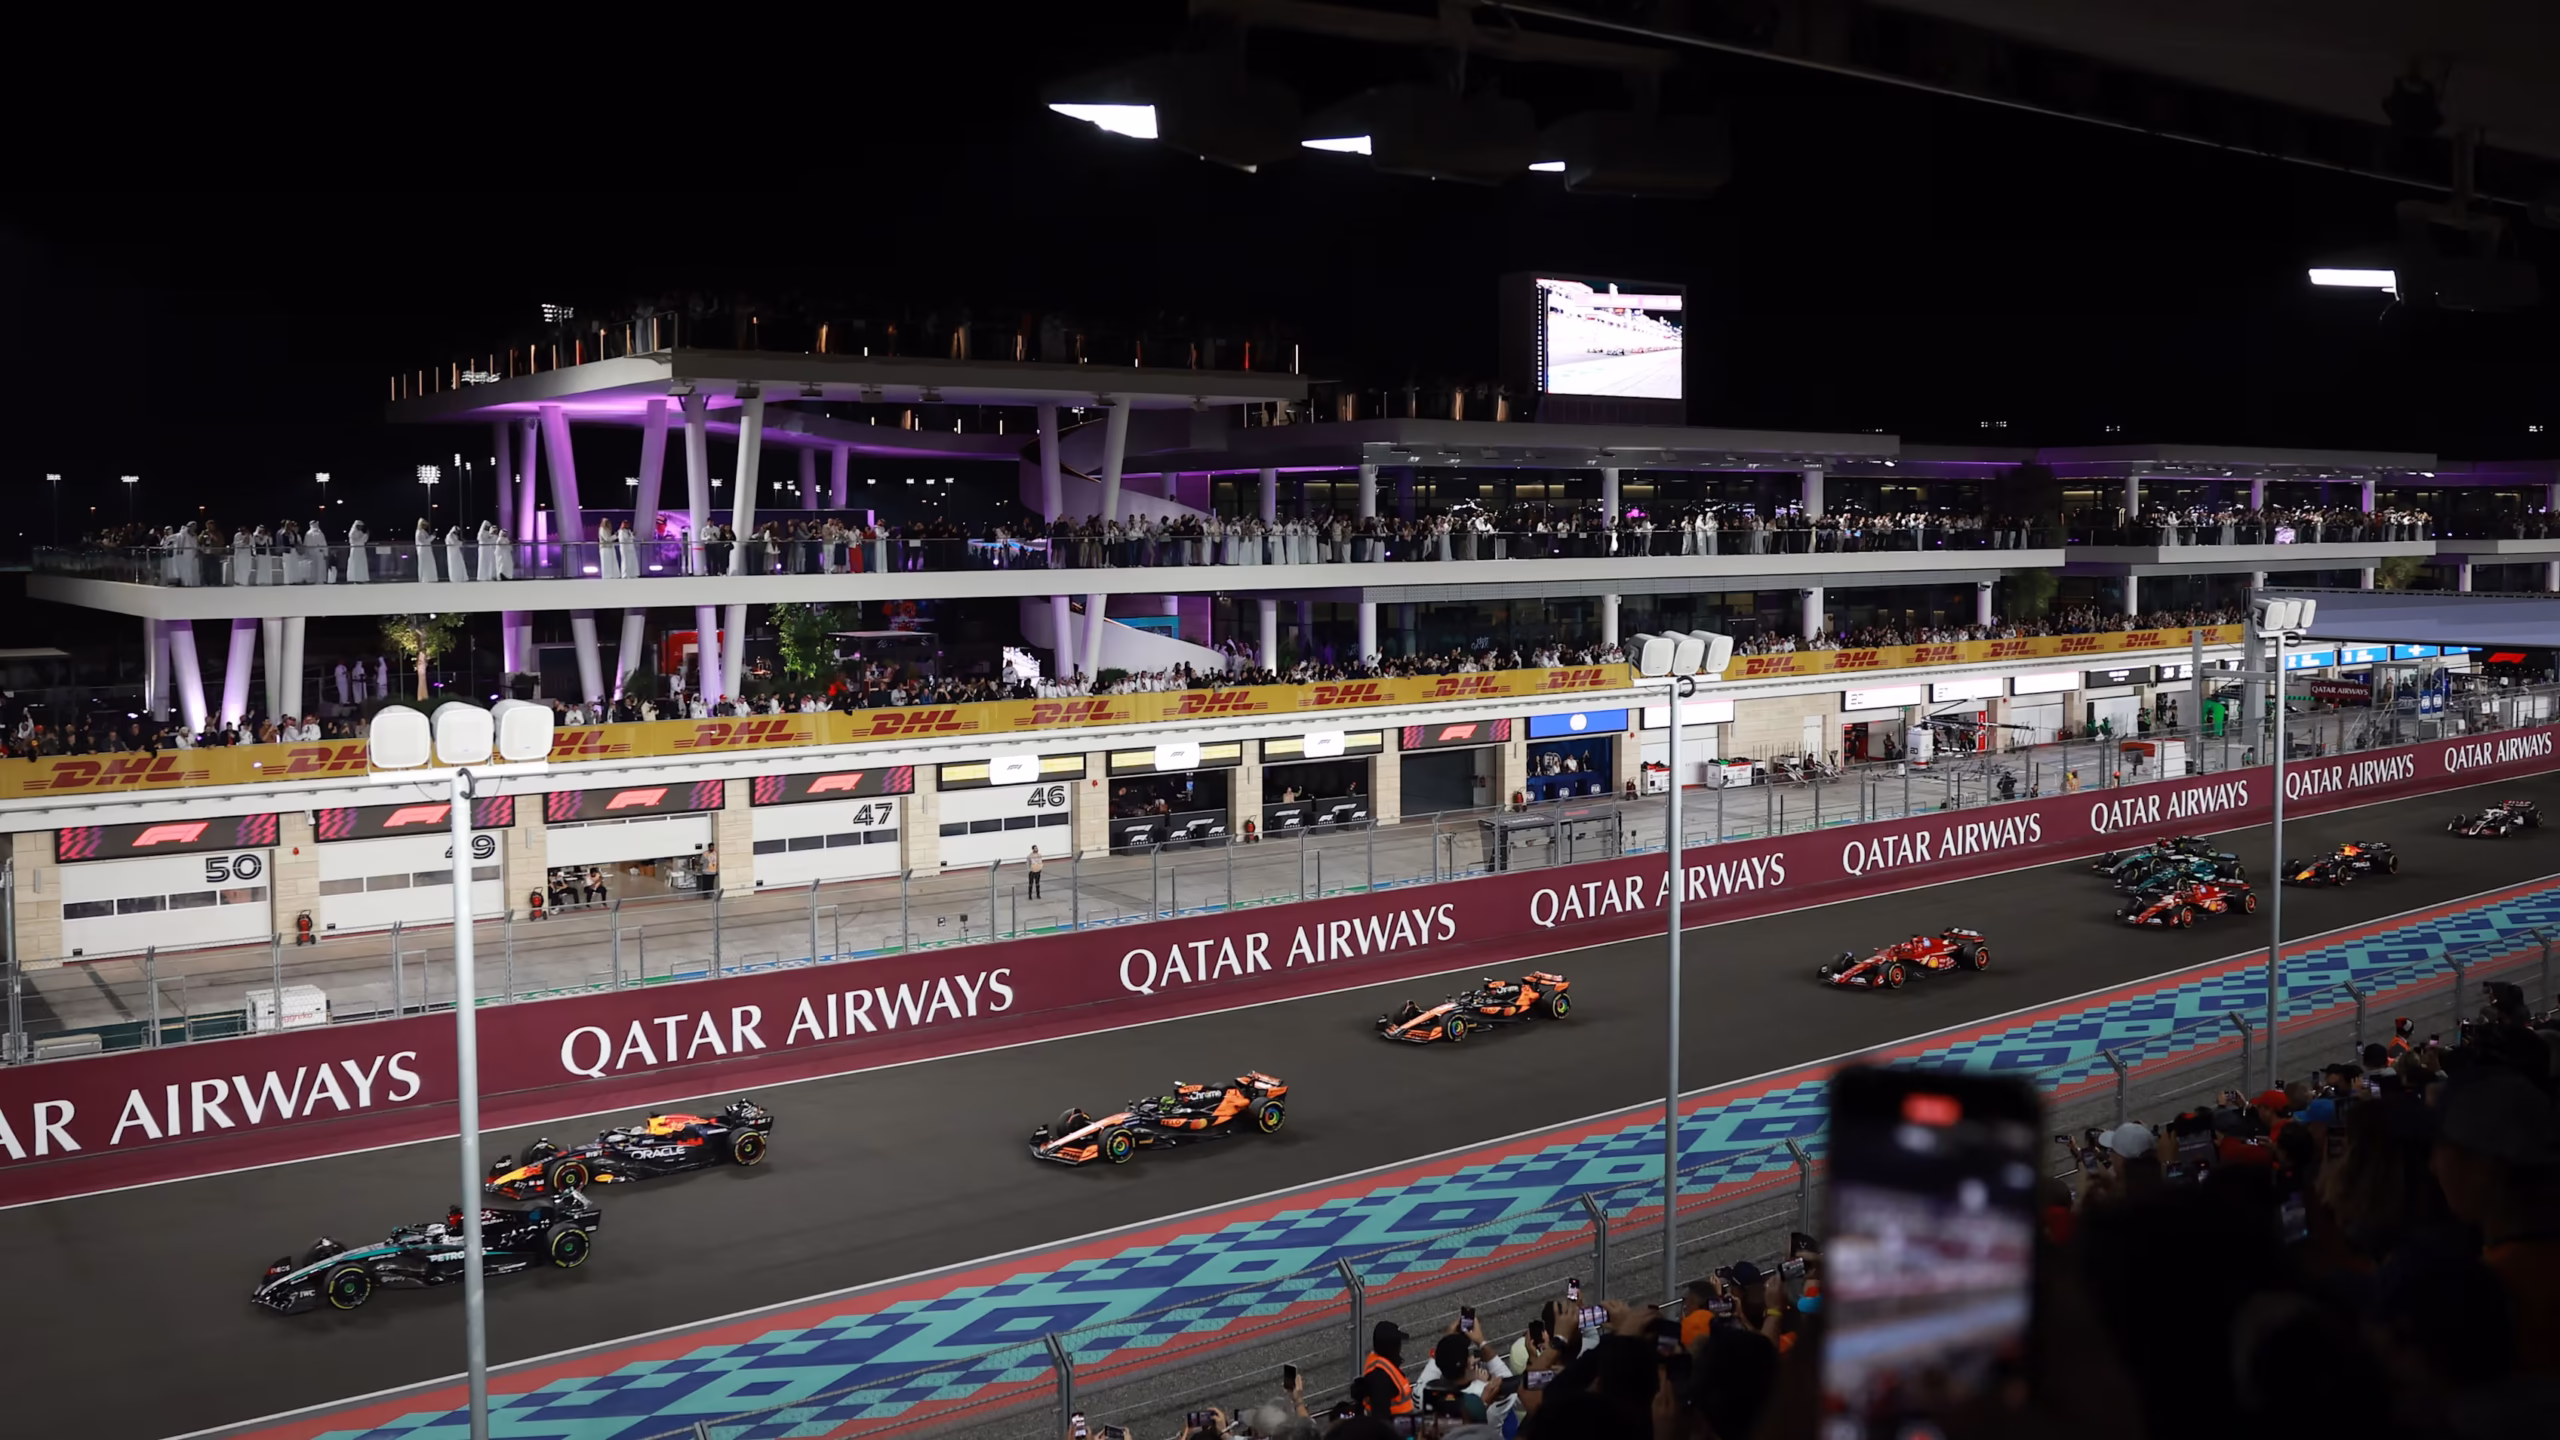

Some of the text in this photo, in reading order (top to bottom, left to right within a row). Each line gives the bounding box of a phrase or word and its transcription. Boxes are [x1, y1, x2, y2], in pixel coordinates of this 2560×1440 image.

[1990, 641, 2031, 657] DHL
[2060, 636, 2098, 652] DHL
[2125, 632, 2161, 648] DHL
[1745, 656, 1796, 675] DHL
[1833, 651, 1880, 669] DHL
[1914, 645, 1958, 663] DHL
[1435, 675, 1499, 697] DHL
[1547, 668, 1607, 689] DHL
[2311, 685, 2368, 696] QATAR AIRWAYS
[1177, 691, 1255, 715] DHL
[1312, 683, 1383, 706] DHL
[869, 709, 963, 736] DHL
[1030, 700, 1115, 725] DHL
[547, 730, 611, 756] HL
[693, 719, 795, 747] DHL
[286, 745, 370, 773] DH
[2445, 733, 2551, 772] QATAR AIRWAYS
[49, 756, 185, 789] DHL
[2286, 754, 2413, 800] QATAR AIRWAYS
[1027, 786, 1065, 808] 46
[2091, 780, 2248, 834] QATAR AIRWAYS
[853, 803, 893, 826] 47
[445, 835, 495, 859] 9
[1843, 813, 2040, 876] QATAR AIRWAYS
[205, 854, 262, 883] 50
[1531, 876, 1644, 928] QATAR
[1120, 904, 1455, 995] QATAR AIRWAYS
[561, 968, 1013, 1081] QATAR AIRWAYS
[110, 1051, 420, 1144] AIRWAYS
[631, 1147, 686, 1159] ORACLE
[429, 1250, 487, 1262] PETRO
[299, 1289, 316, 1298] IWC
